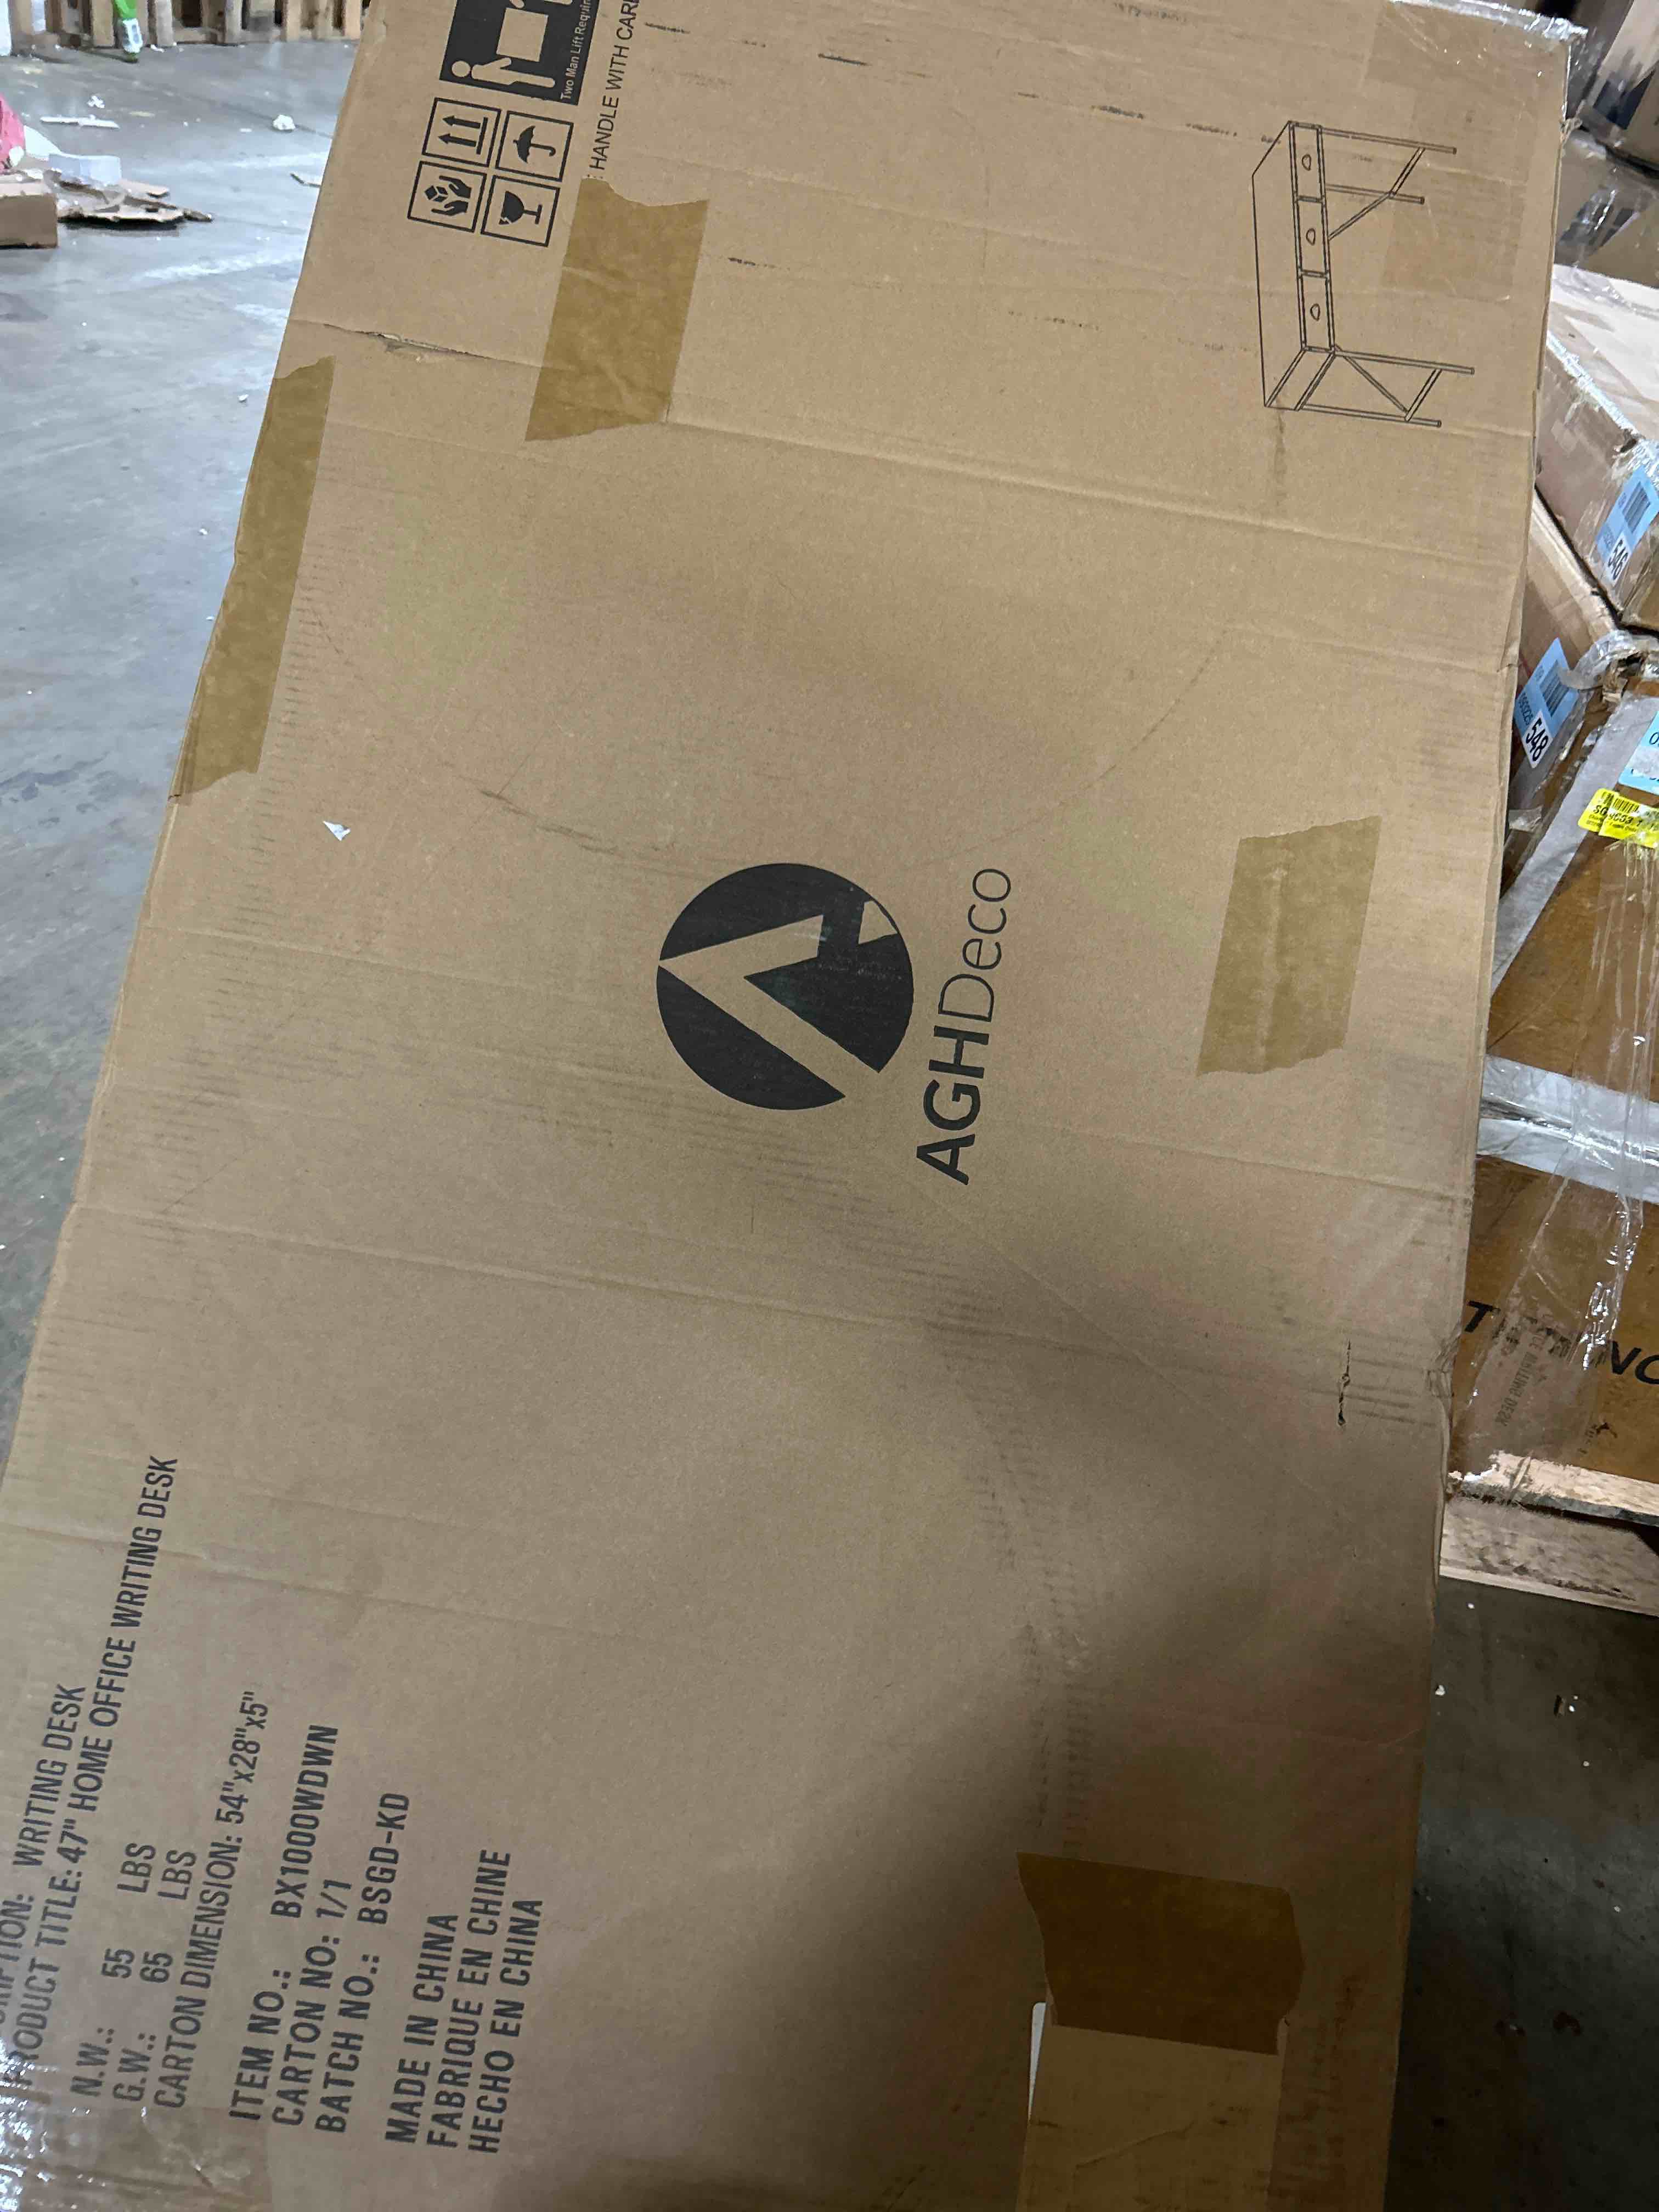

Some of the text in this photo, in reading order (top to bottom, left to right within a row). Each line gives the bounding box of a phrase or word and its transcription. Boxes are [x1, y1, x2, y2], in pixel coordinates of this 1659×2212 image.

[560, 80, 574, 99] Two
[566, 58, 580, 77] Man
[571, 36, 584, 54] Lift
[590, 95, 619, 170] HANDLE
[606, 44, 630, 90] WITH
[1608, 539, 1628, 580] 546
[1526, 718, 1549, 761] 548
[917, 868, 1012, 1186] AGHDeco
[138, 1455, 178, 1519] DESK
[111, 1526, 163, 1627] WRITING
[89, 1637, 136, 1727] OFFICE
[13, 1759, 67, 1866] WRITING
[42, 1684, 86, 1750] DESK
[68, 1735, 112, 1812] HOME
[57, 1818, 89, 1863] 47"
[35, 1870, 82, 1946] TITLE:
[70, 1843, 156, 2097] N.W.: 55 LBS
[229, 1724, 338, 2120] ITEM NO.: BX1000WDWN
[314, 1792, 410, 2133] BATCH NO.: BSGD-KD
[112, 1849, 197, 2102] G.W.: 65 LBS
[154, 1996, 206, 2108] CARTON
[180, 1835, 242, 1989] DIMENSION:
[272, 1879, 352, 2126] CARTON NO: 1/1
[386, 1914, 460, 2143] MADE IN CHINA
[426, 1850, 511, 2148] FABRIQUE EN CHINE
[468, 1900, 543, 2153] HECHO EN CHINA
